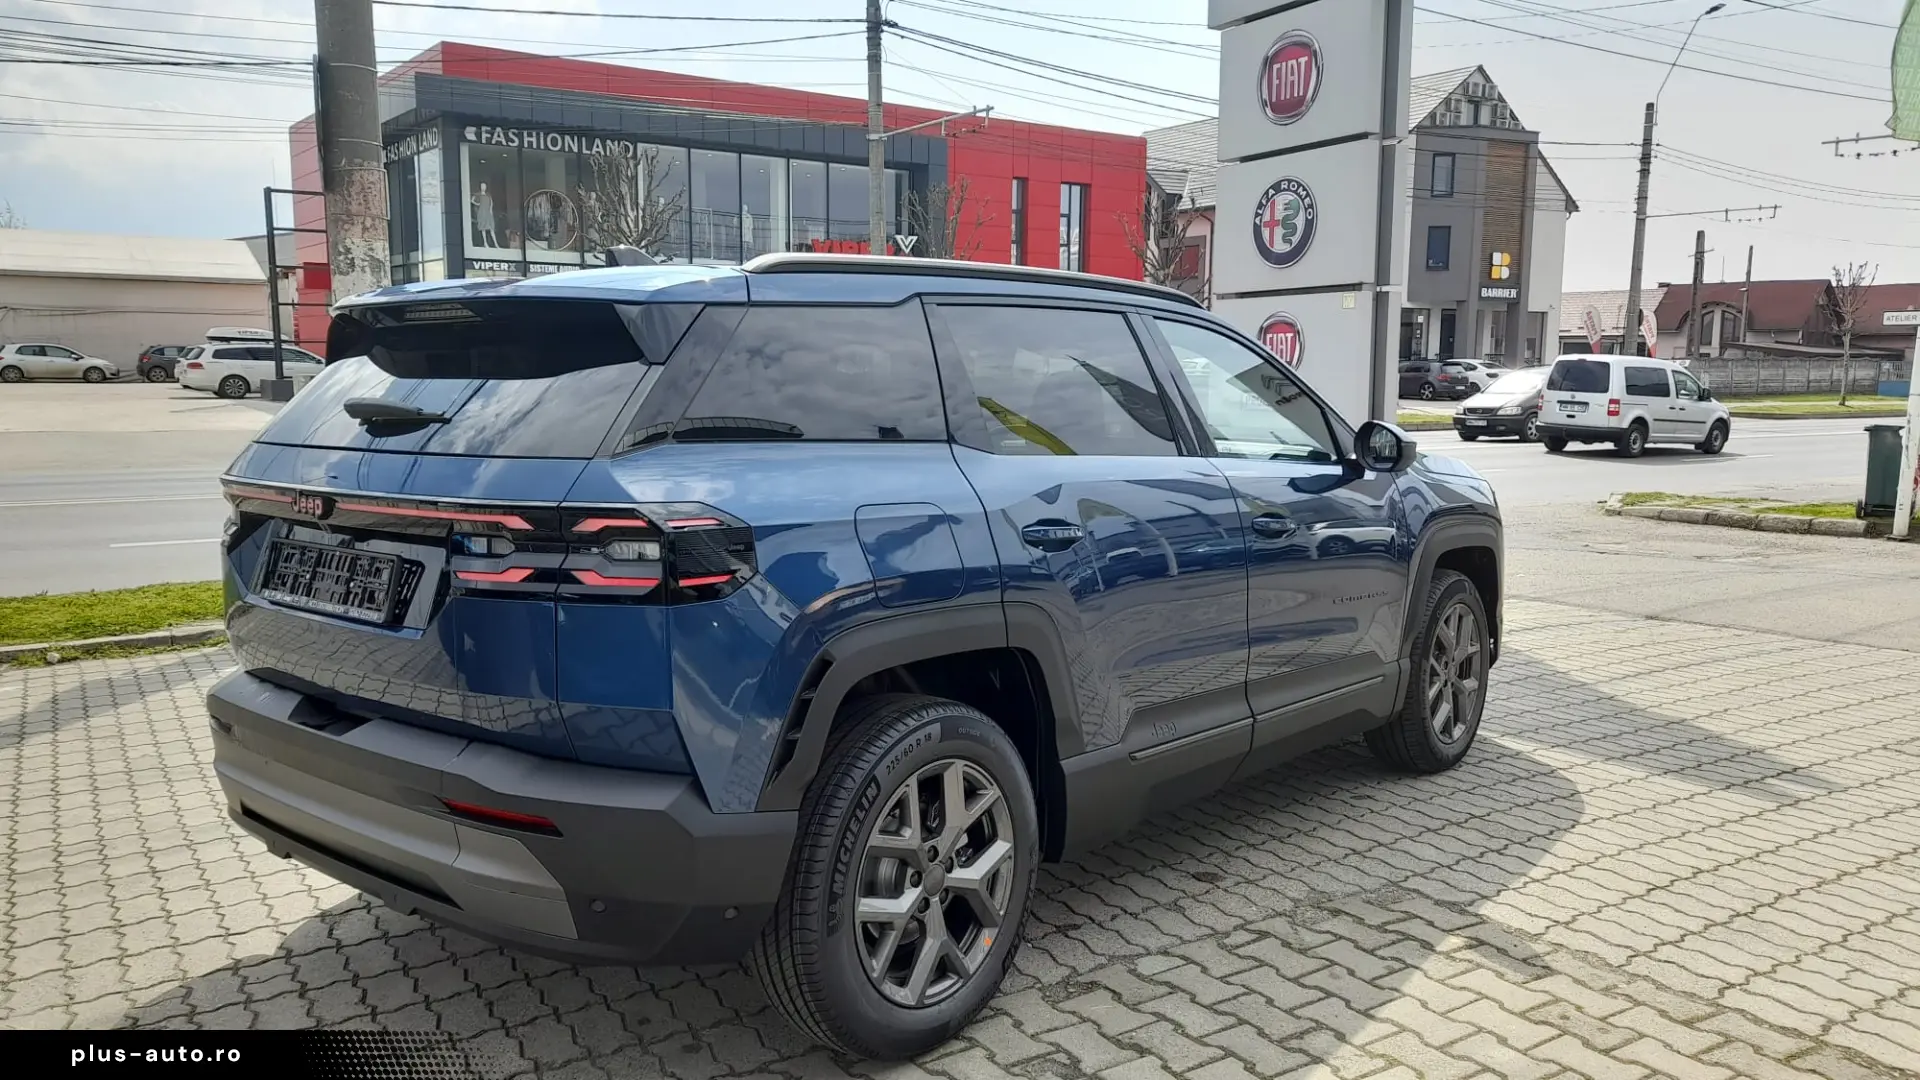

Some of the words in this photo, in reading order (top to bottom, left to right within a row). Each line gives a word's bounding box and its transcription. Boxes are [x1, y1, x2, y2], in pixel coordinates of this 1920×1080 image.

[1271, 56, 1309, 103] FIAT
[1254, 188, 1276, 226] ALFA
[1280, 181, 1314, 219] ROMEO
[1266, 332, 1294, 362] FIAT
[291, 489, 323, 518] Jeep
[885, 743, 915, 776] 225/60
[915, 738, 922, 750] R
[923, 732, 933, 742] 18
[832, 779, 881, 894] MICHELIN
